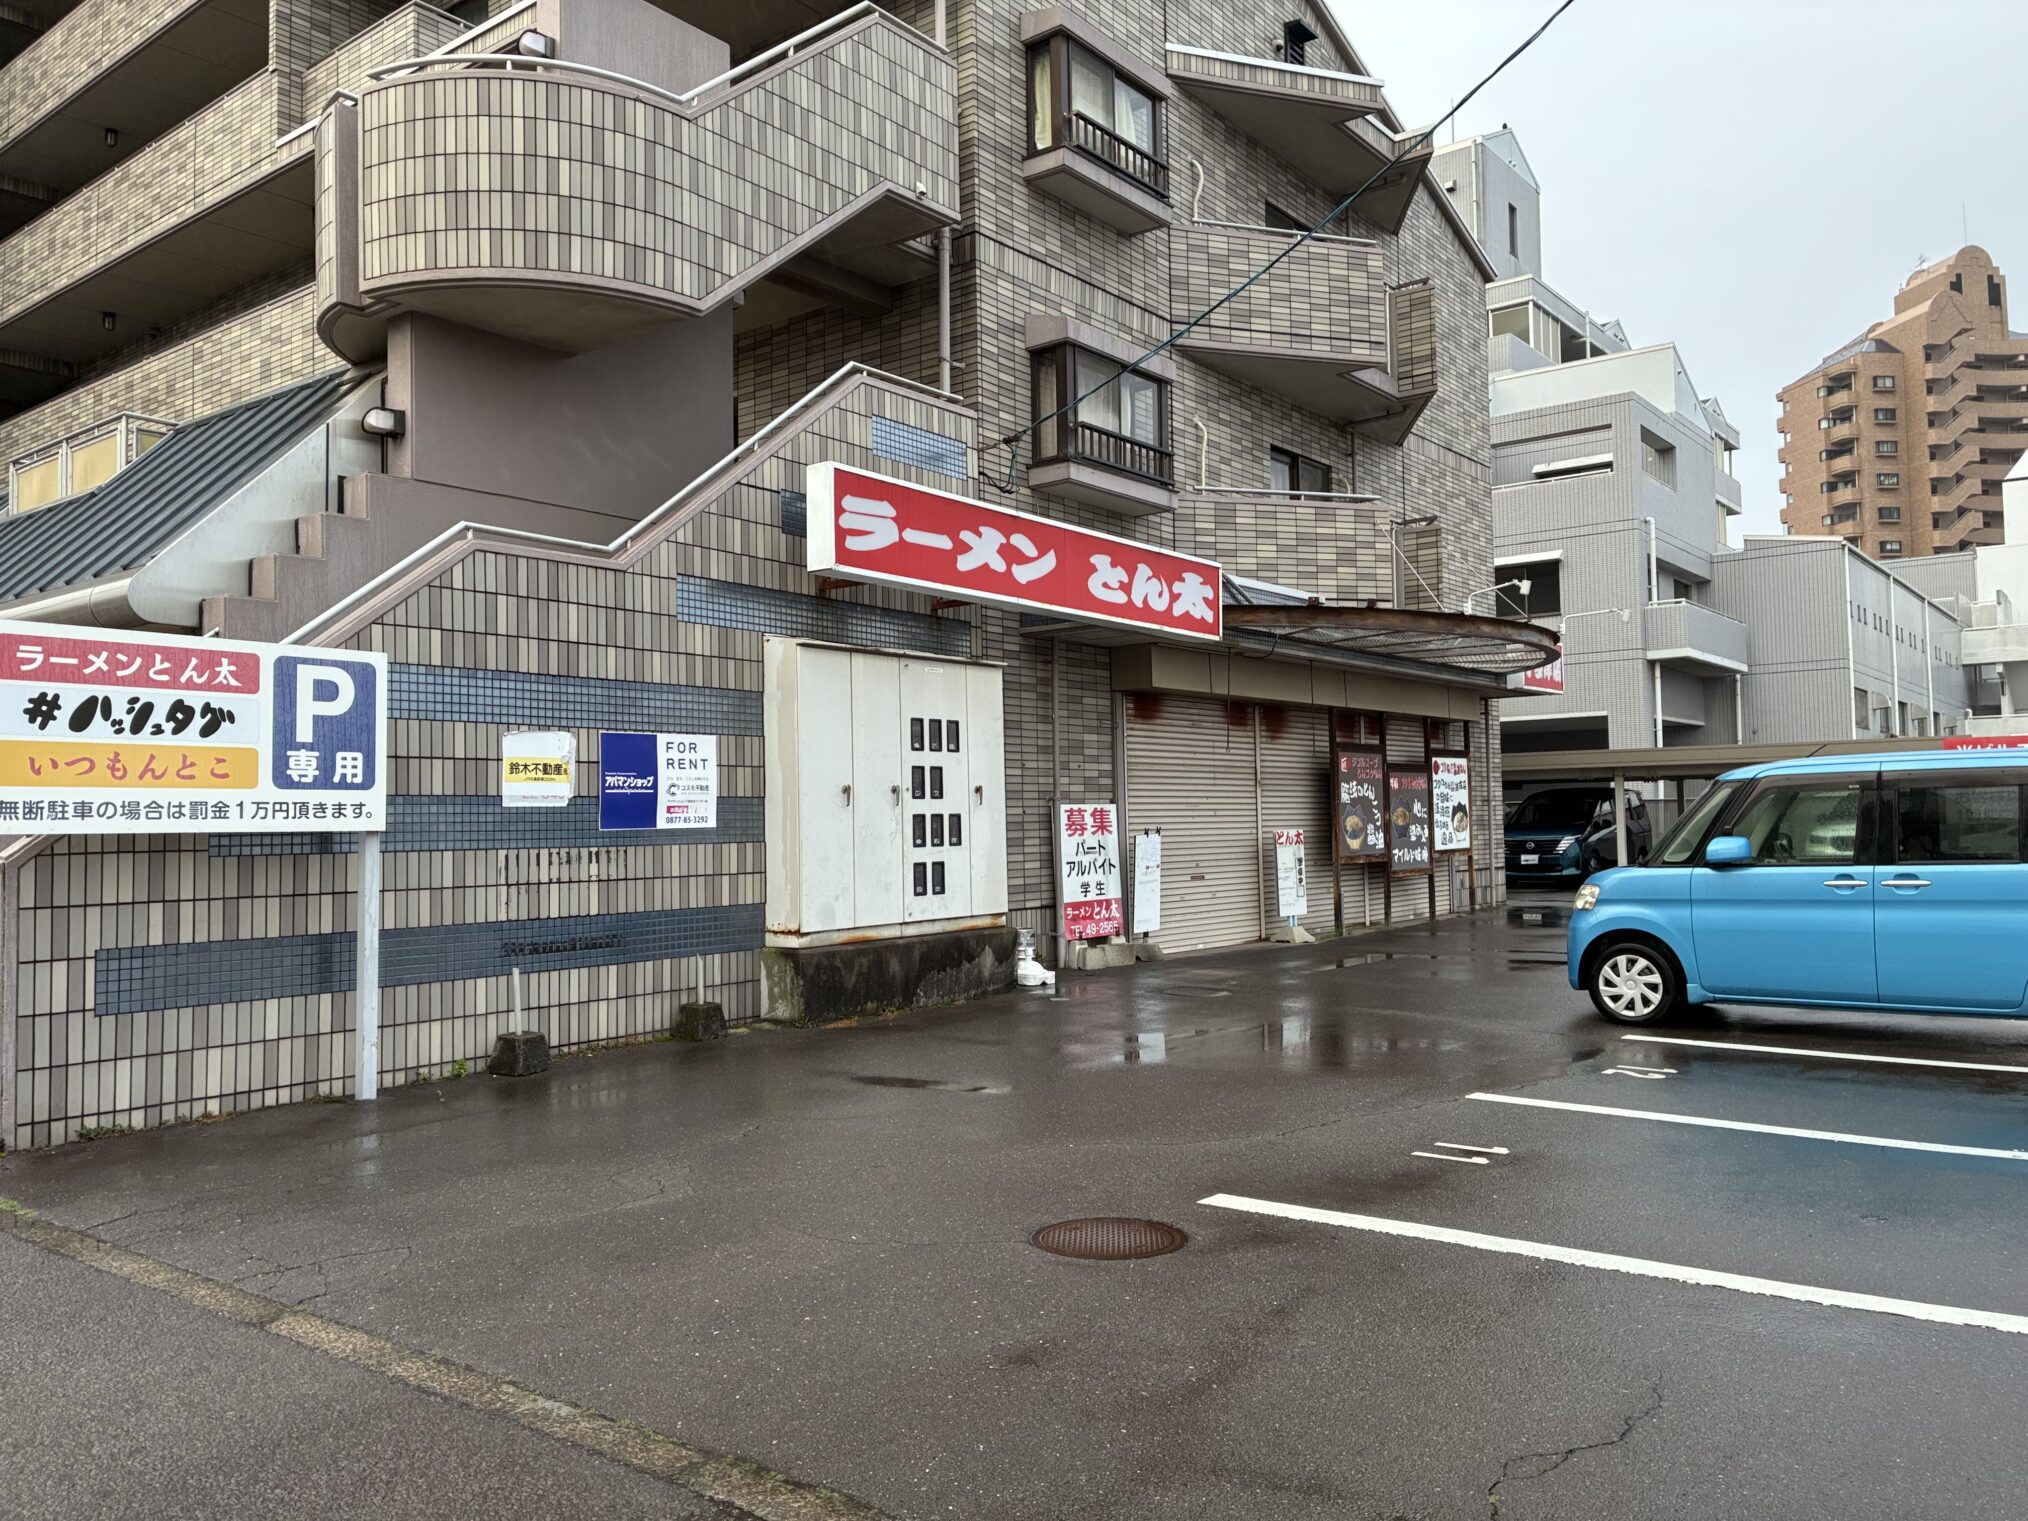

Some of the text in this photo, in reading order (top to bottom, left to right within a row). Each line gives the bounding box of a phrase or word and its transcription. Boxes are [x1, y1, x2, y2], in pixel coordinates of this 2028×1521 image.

[837, 494, 1215, 624] ラーメン とん太
[15, 643, 243, 688] ラーメンとん太
[295, 663, 356, 744] P
[665, 742, 698, 754] FOR
[28, 750, 231, 781] いつもんとこ
[285, 749, 364, 784] 専用
[666, 758, 709, 770] RENT
[604, 775, 655, 788] アパマンショップ
[665, 815, 709, 825] 0877-85-3292
[1064, 807, 1114, 838] 募集
[1075, 838, 1106, 857] パート
[1276, 829, 1304, 847] とん太
[1065, 857, 1116, 878] アルバイト
[1080, 880, 1106, 898] 学生
[1066, 898, 1121, 920] ラーメン とん太
